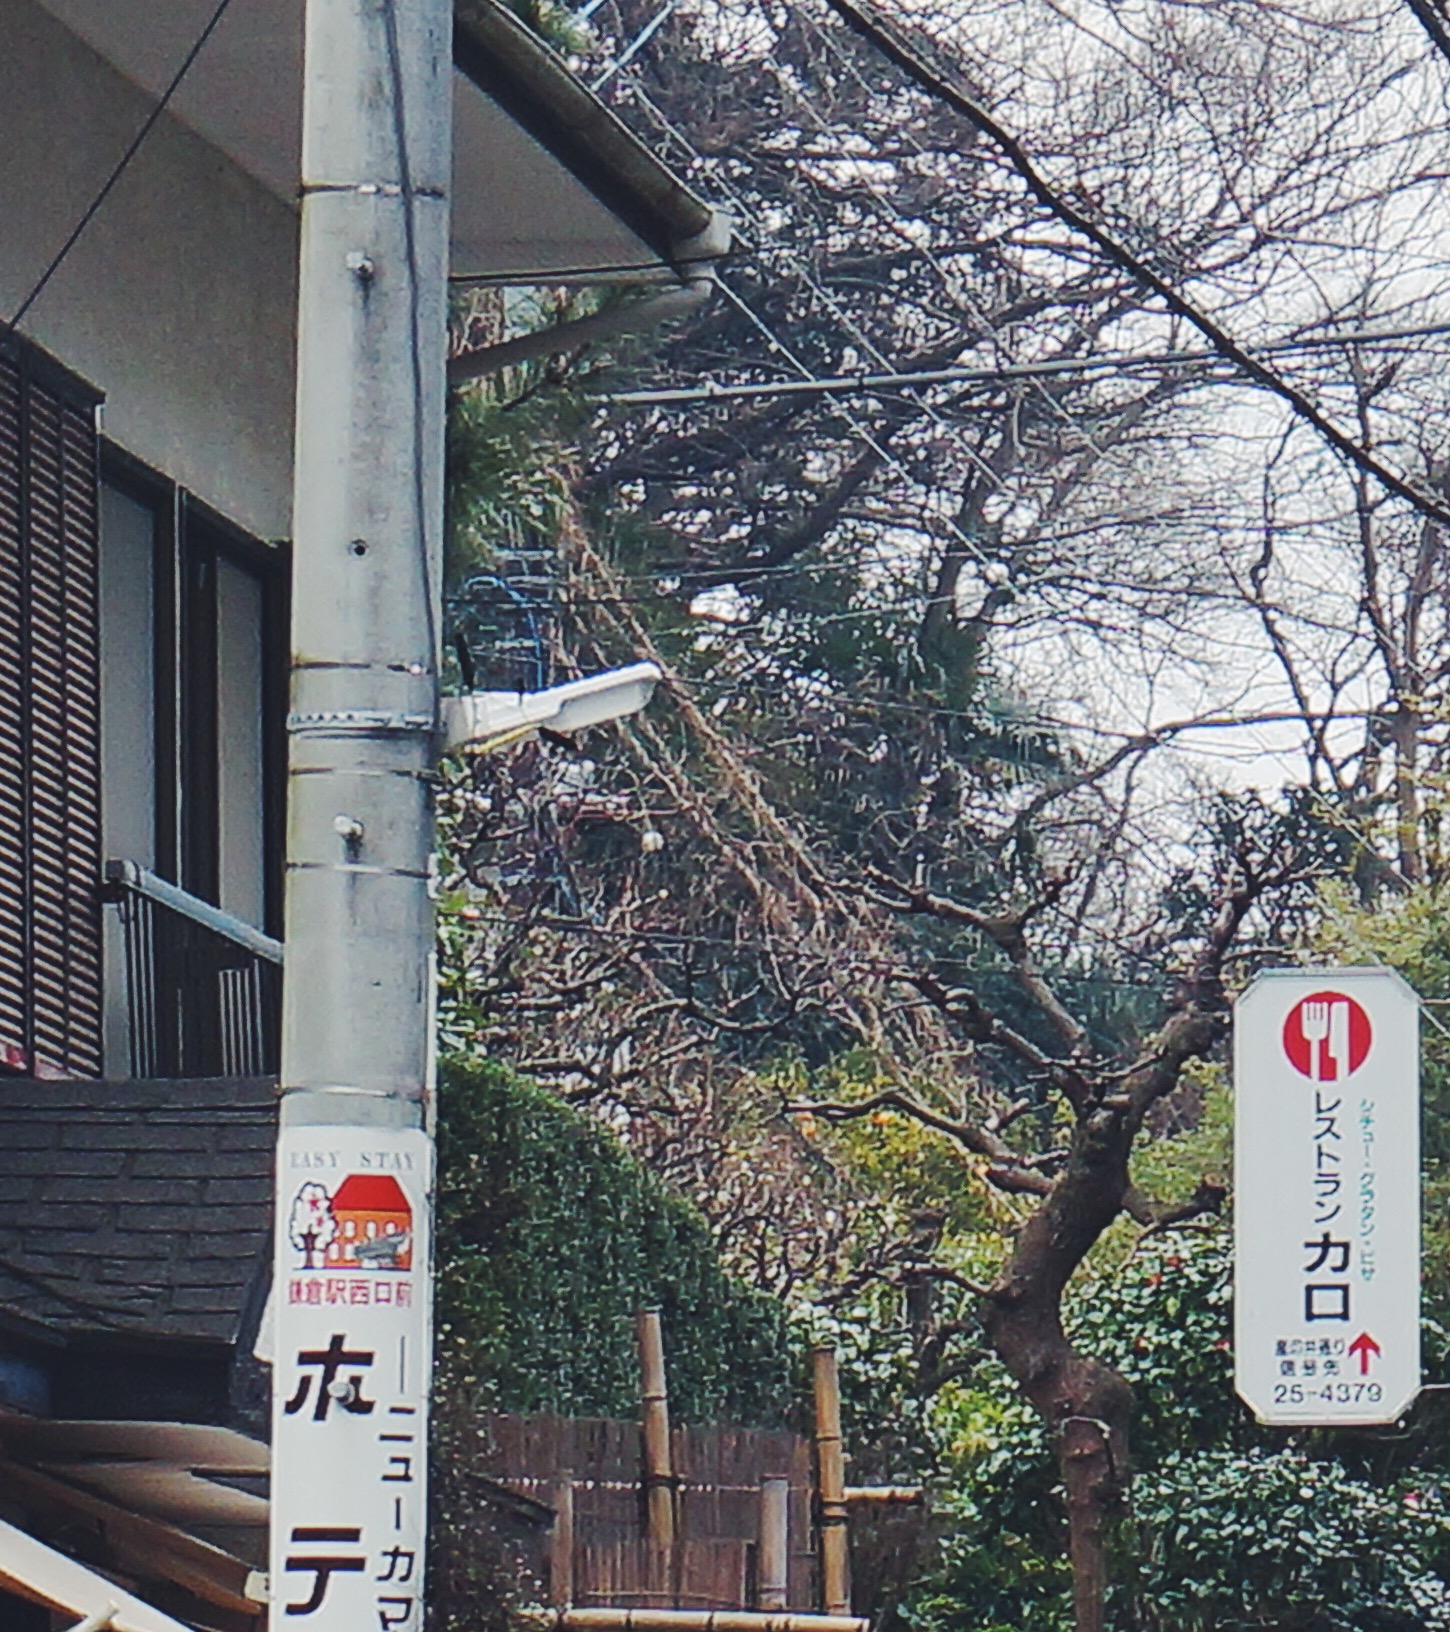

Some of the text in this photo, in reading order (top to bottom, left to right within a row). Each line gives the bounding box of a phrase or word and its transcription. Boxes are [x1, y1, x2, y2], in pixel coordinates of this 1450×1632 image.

[290, 1151, 415, 1171] EASY STAY
[288, 1278, 413, 1308] 鎌倉駅西口前
[1274, 1382, 1383, 1404] 25-4379
